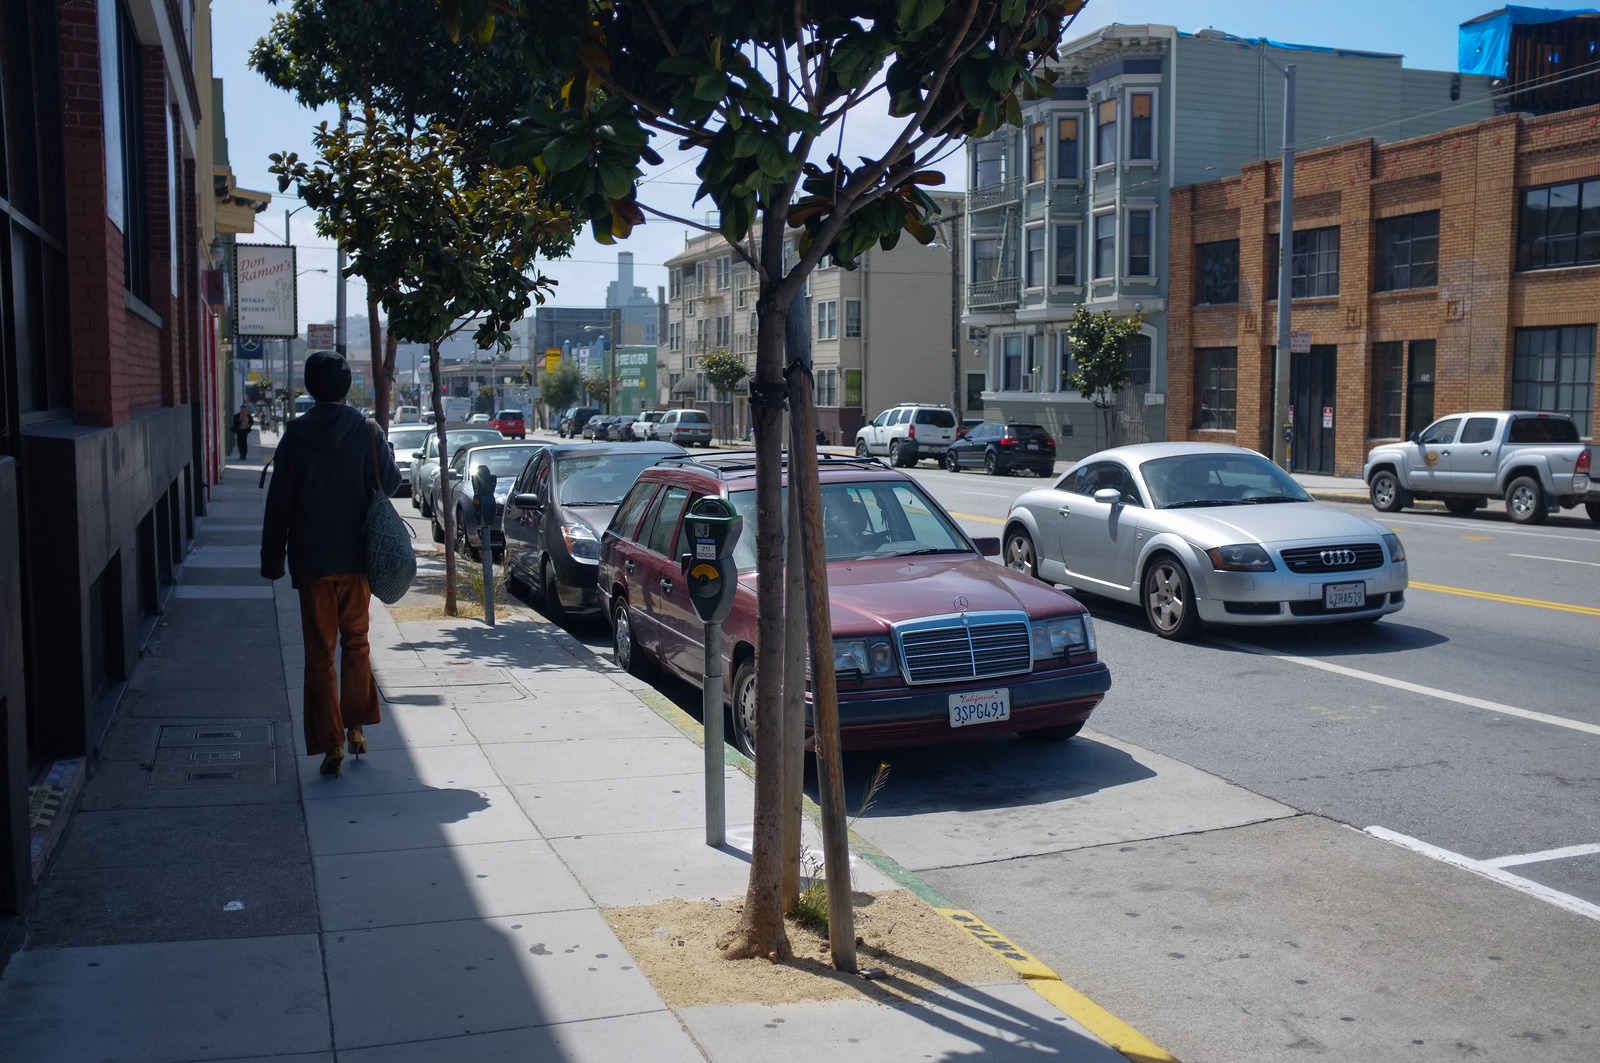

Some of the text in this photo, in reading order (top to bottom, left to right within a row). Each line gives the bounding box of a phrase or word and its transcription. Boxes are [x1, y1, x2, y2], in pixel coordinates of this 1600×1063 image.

[239, 256, 265, 272] Don
[239, 259, 292, 284] Ramon's
[1329, 592, 1363, 605] 4ZRA579
[962, 694, 998, 704] California
[954, 701, 1006, 722] 3SPG491
